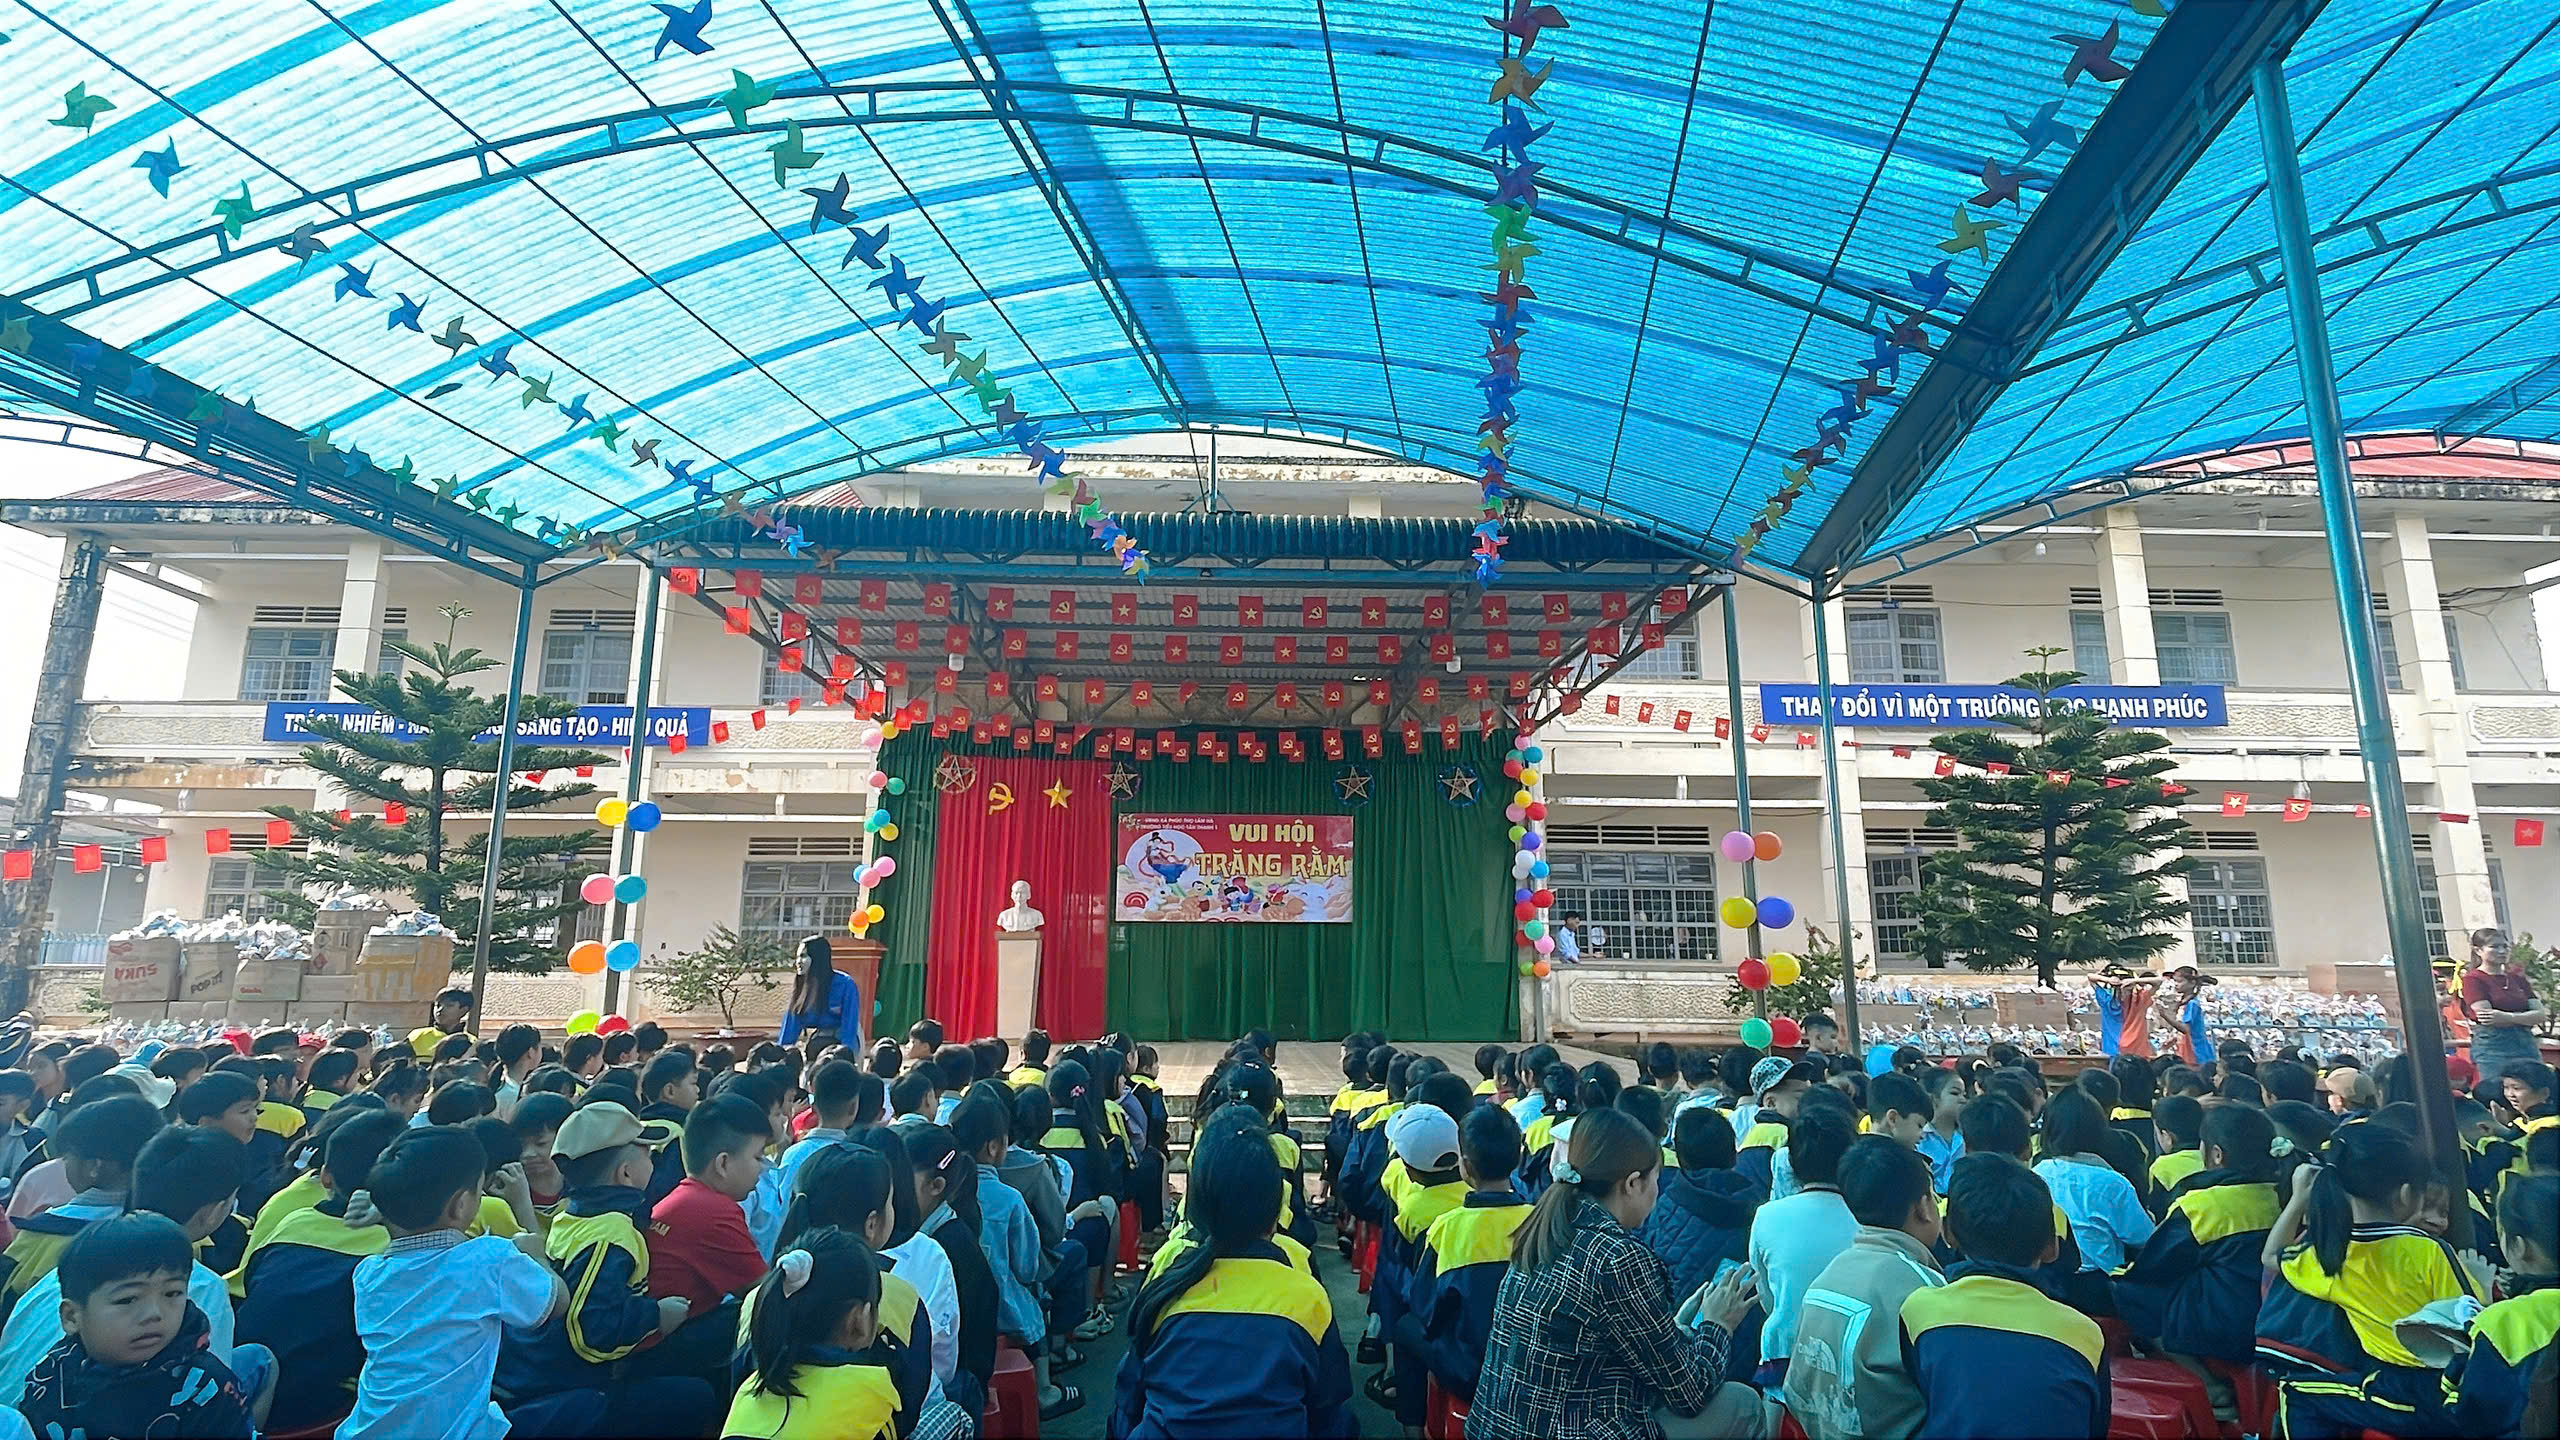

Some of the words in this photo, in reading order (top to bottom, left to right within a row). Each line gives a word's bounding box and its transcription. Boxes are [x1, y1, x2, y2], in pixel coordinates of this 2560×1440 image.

[1842, 688, 1877, 717] ĐỔI
[1881, 692, 1904, 717] VÌ
[1908, 693, 1951, 723] MỘT
[1957, 693, 2040, 719] TRƯỜNG
[2154, 693, 2207, 719] PHÚC
[566, 716, 599, 741] TẠO
[611, 717, 651, 736] HI
[654, 711, 688, 737] QUẢ
[1228, 823, 1268, 842] VUI
[1274, 818, 1315, 848] HỘI
[1195, 847, 1282, 879] TRĂNG
[1290, 845, 1347, 879] RẰM
